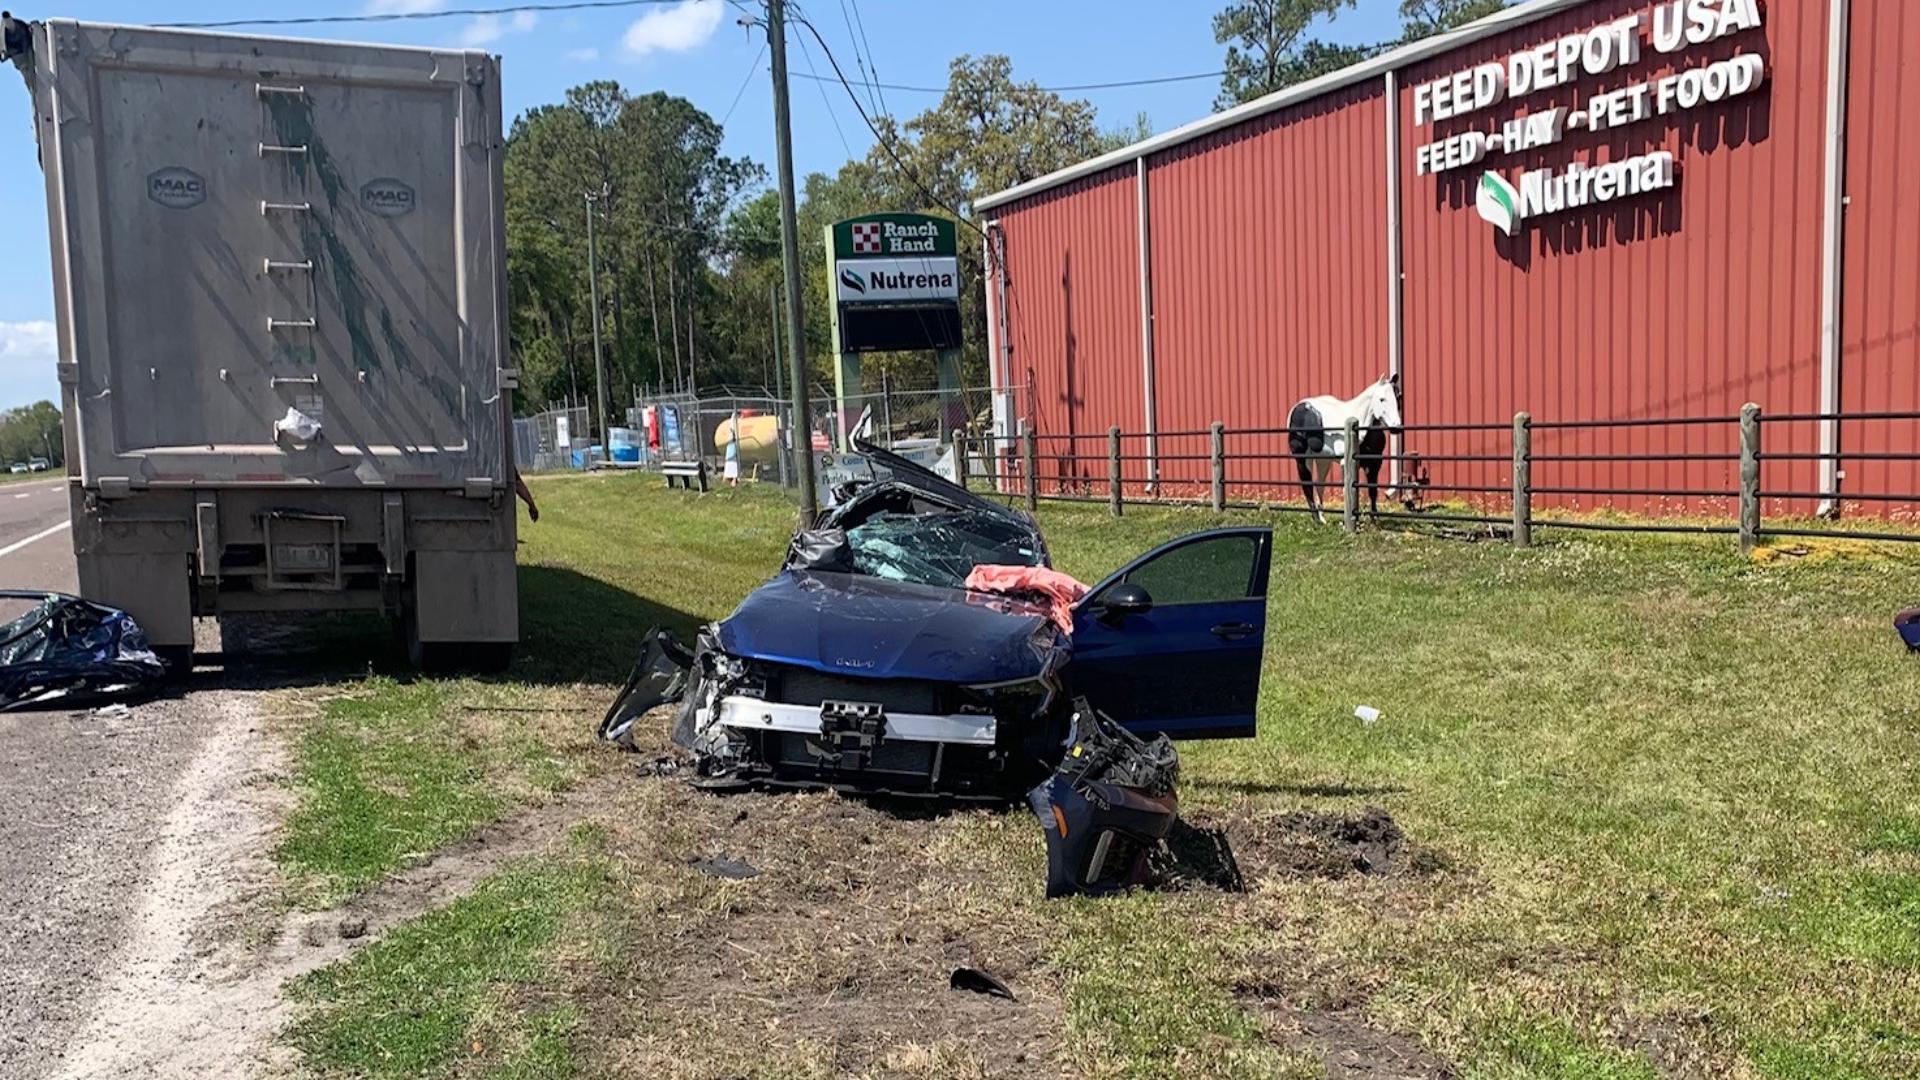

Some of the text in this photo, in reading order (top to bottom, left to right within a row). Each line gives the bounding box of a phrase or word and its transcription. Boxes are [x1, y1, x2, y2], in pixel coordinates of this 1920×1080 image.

[1414, 0, 1762, 126] FEED DEPOT USA
[1416, 53, 1763, 176] FEED HAY PET FOOD
[154, 179, 201, 191] MAC
[1519, 151, 1673, 219] Nutrena
[366, 190, 410, 202] MAC
[883, 221, 939, 238] Ranch
[889, 237, 936, 252] Hand
[870, 271, 952, 290] Nutrena
